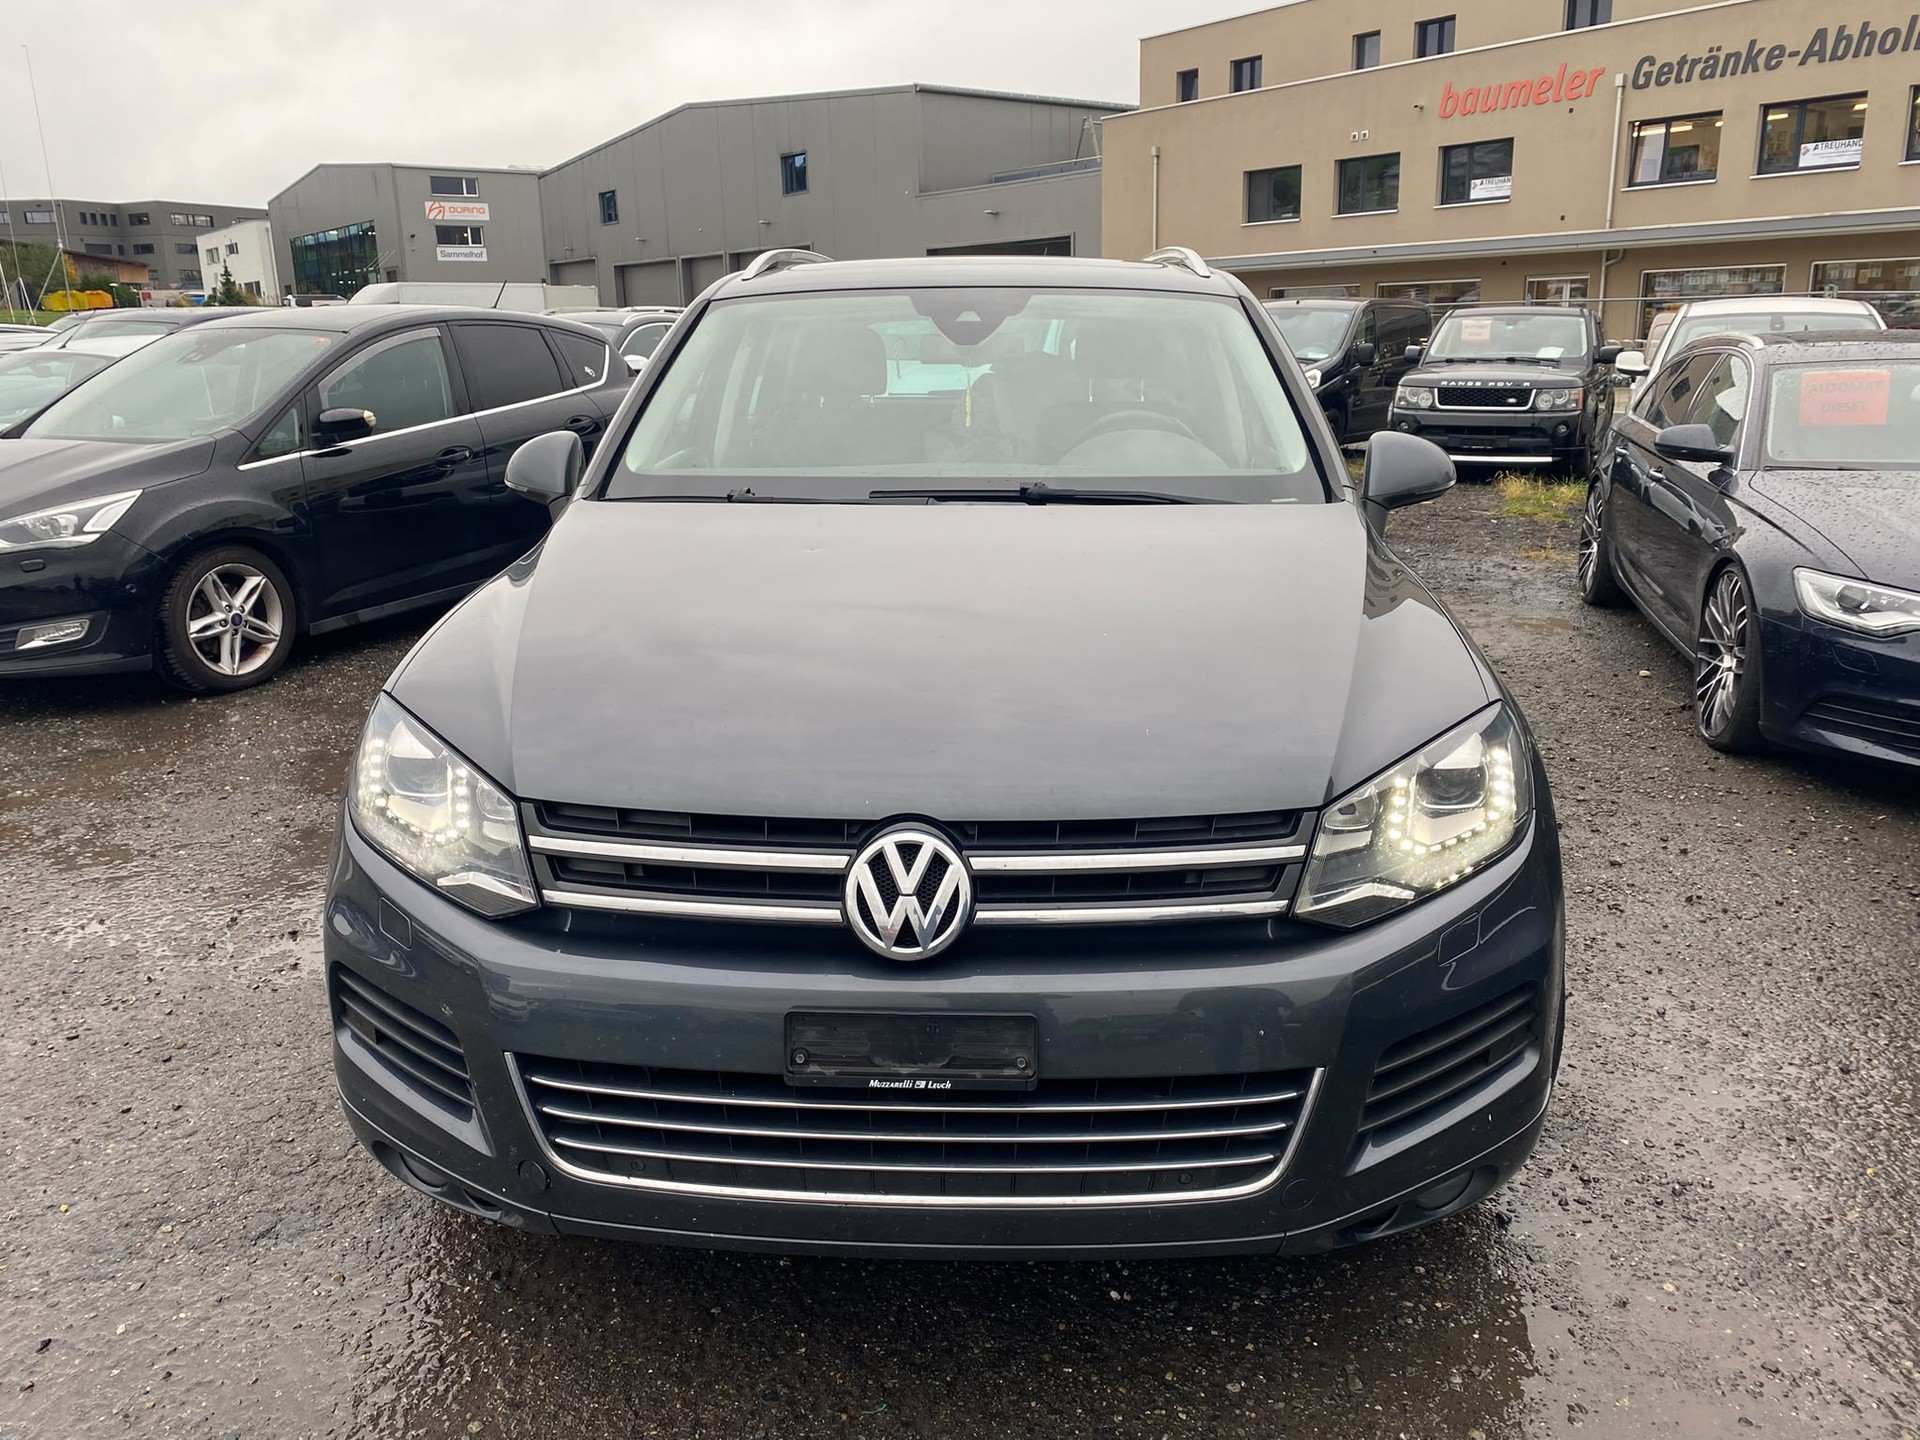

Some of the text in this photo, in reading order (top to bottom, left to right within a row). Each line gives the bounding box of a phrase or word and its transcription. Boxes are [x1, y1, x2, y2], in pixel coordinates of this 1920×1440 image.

[1632, 14, 1920, 90] Getränke-Abhol
[1439, 62, 1606, 118] baumeler
[440, 250, 484, 258] Sammelhof
[1808, 379, 1884, 394] AUTOMAT
[1821, 400, 1868, 413] DIESEL
